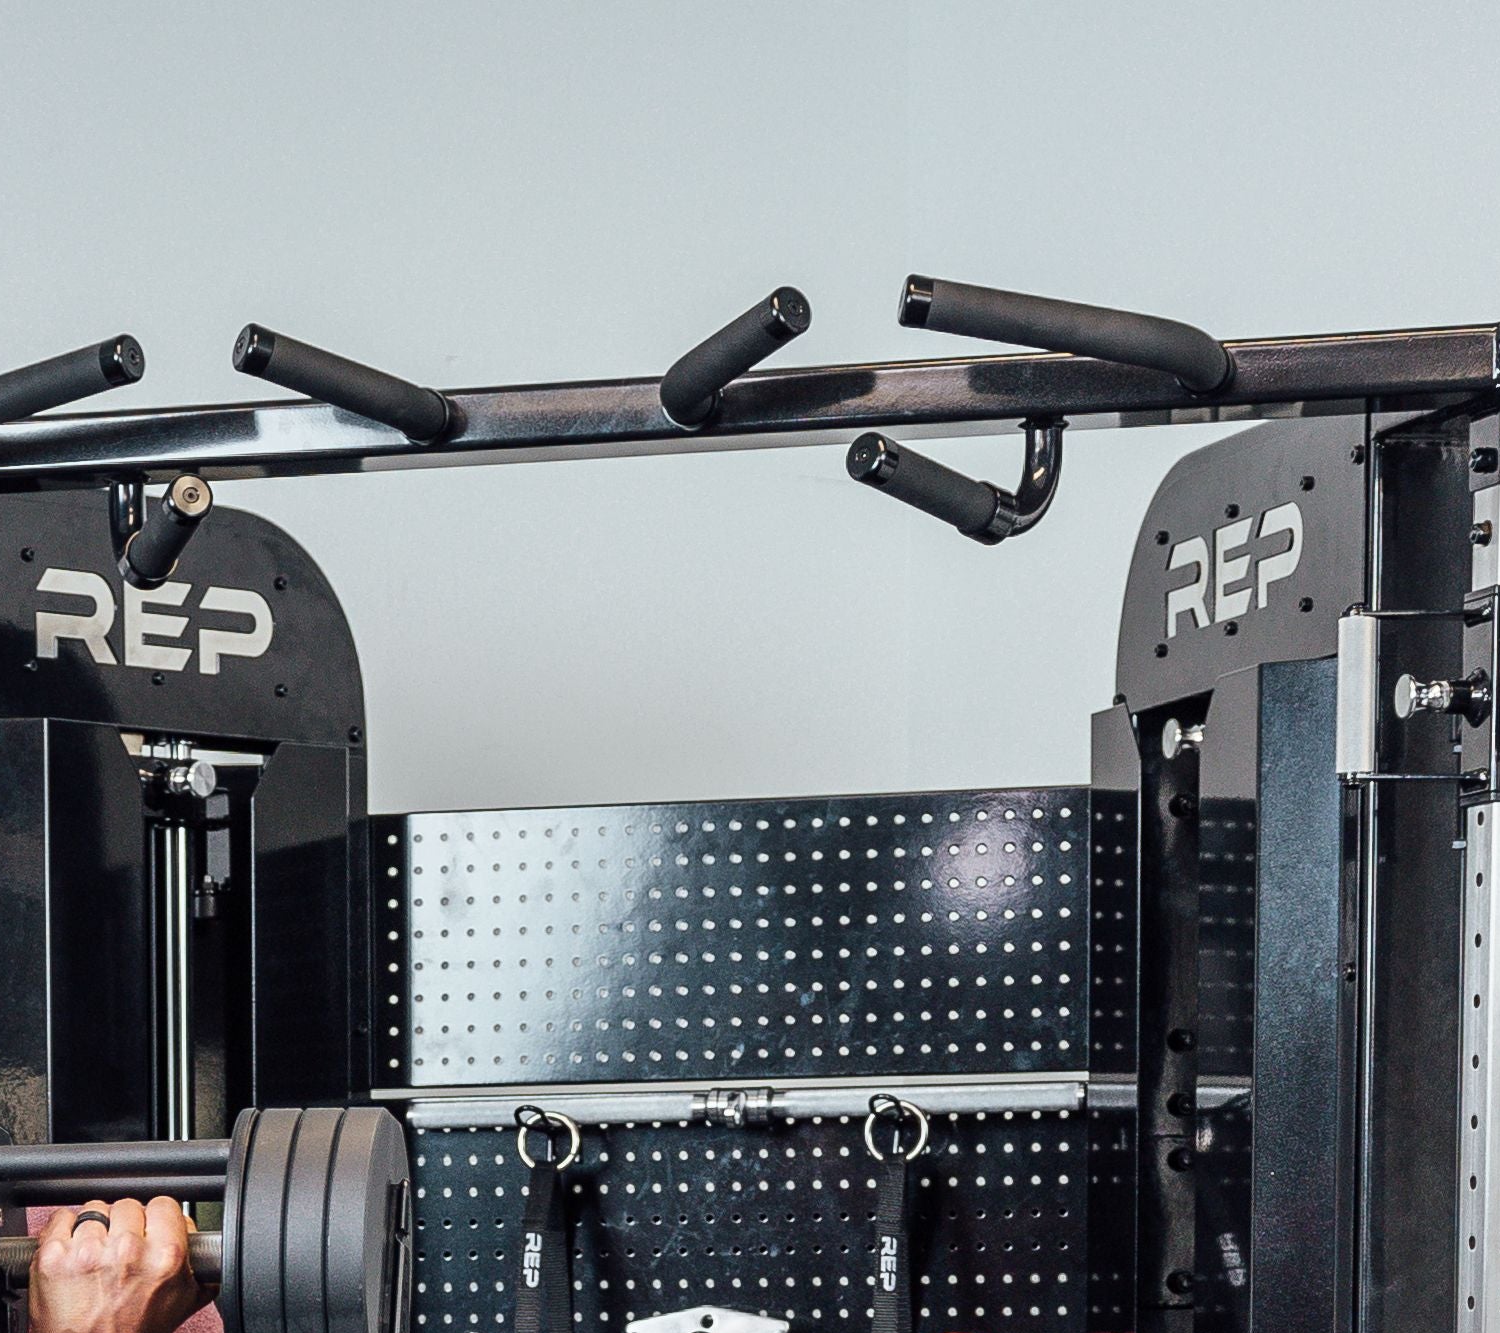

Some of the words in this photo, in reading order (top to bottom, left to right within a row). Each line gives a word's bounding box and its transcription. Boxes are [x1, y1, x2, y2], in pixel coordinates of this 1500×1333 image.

[1165, 501, 1304, 639] REP
[35, 567, 275, 676] REP
[522, 1231, 543, 1289] REP
[879, 1235, 898, 1292] REP
